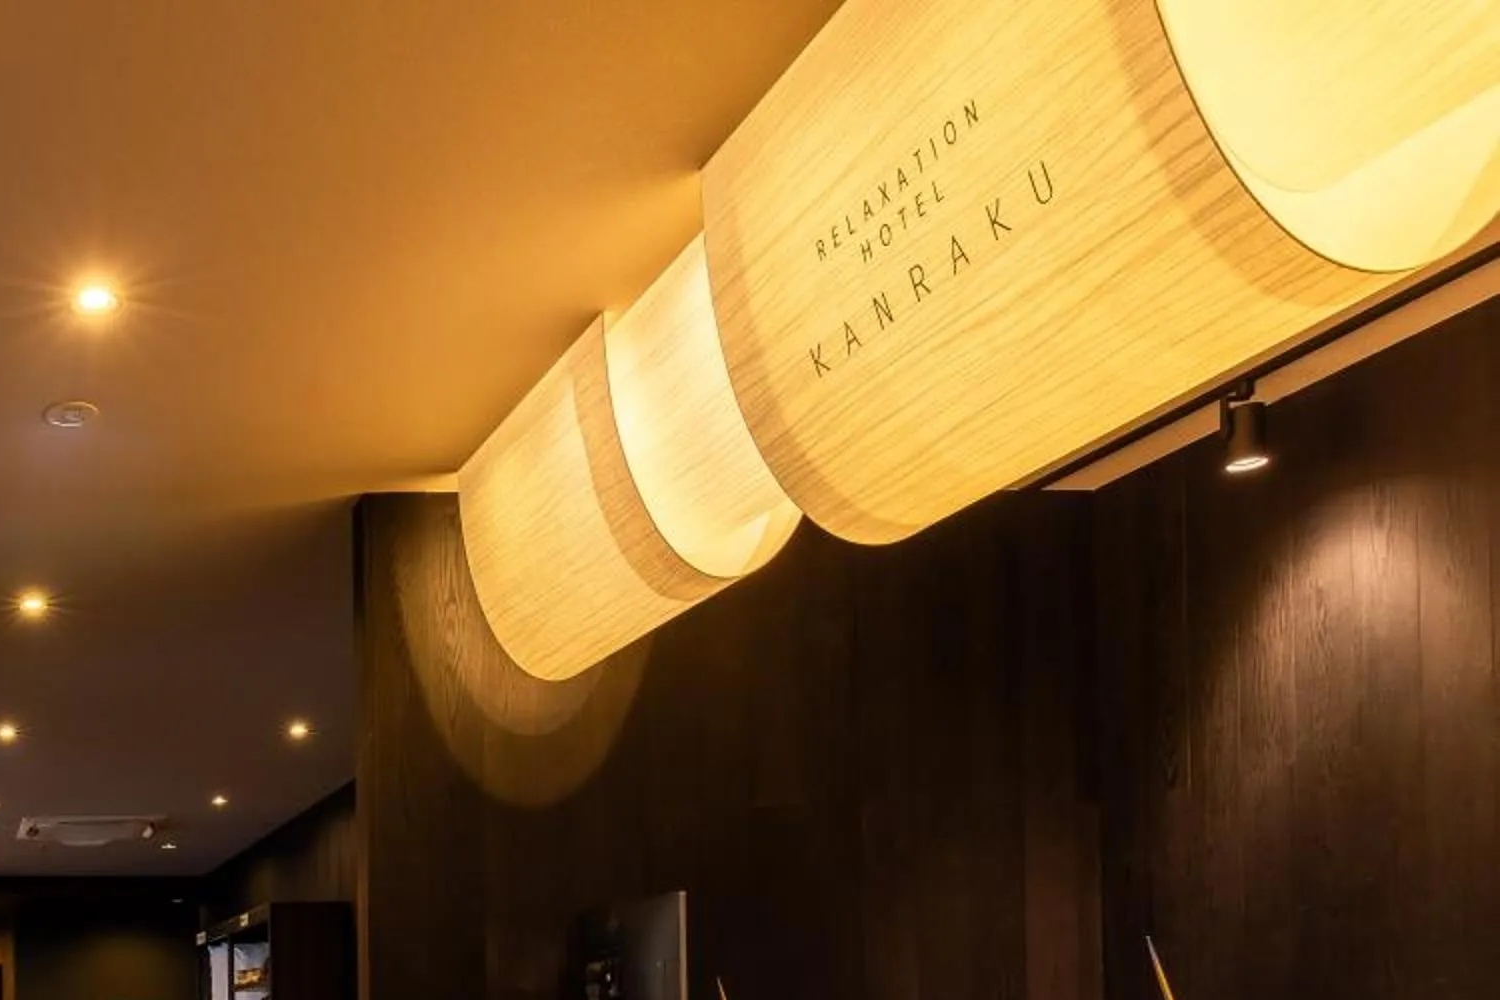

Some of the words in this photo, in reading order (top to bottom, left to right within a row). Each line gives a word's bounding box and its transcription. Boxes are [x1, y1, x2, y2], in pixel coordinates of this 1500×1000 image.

[815, 100, 980, 262] RELAXATION
[860, 180, 945, 263] HOTEL
[808, 160, 1054, 378] KANRAKU
